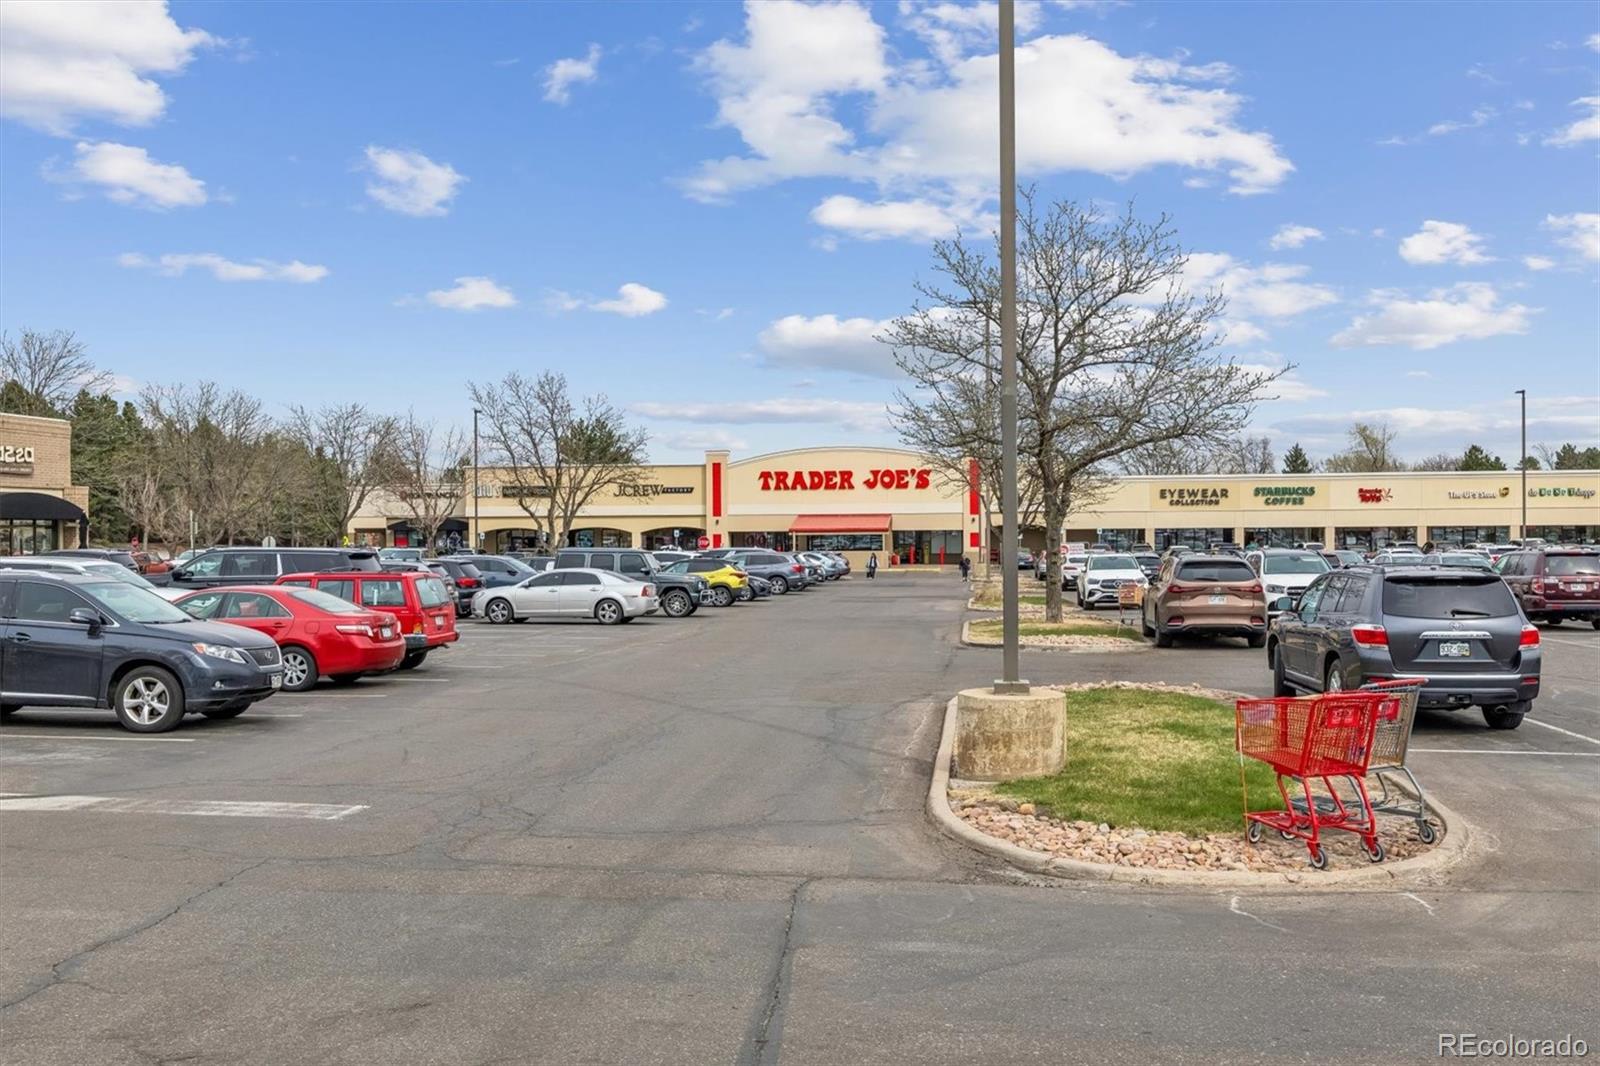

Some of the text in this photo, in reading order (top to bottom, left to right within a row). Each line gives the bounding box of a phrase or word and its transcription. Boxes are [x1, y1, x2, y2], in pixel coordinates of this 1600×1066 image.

[758, 468, 933, 491] TRADER JOE'S
[1159, 488, 1229, 499] EYEWEAR
[1253, 486, 1315, 497] STARBUCKS
[1169, 498, 1220, 506] COLLECTION
[1264, 496, 1304, 506] COFFEE
